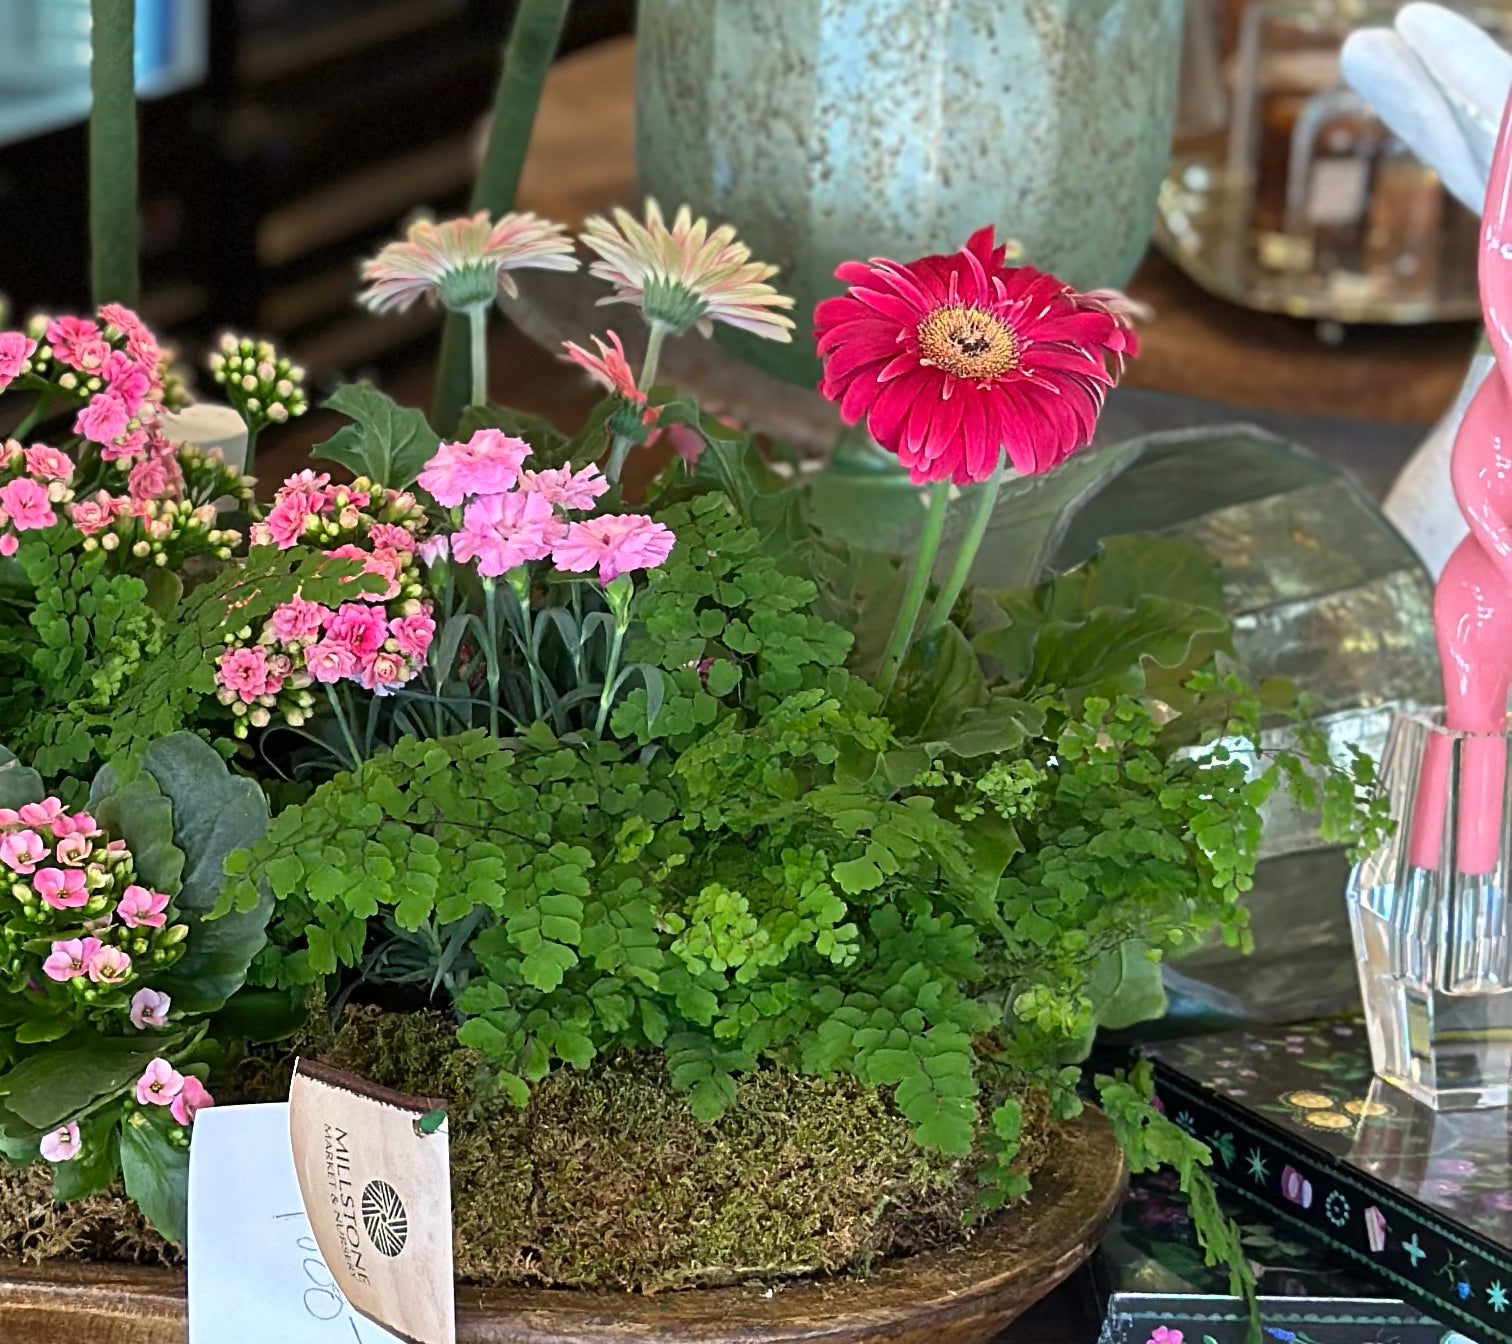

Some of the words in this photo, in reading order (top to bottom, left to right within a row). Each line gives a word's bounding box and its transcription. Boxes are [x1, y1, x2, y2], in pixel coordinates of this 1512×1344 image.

[324, 1123, 337, 1188] MARKET
[330, 1193, 339, 1203] &
[334, 1127, 371, 1287] MILLSTONE
[333, 1209, 357, 1278] NURSERY
